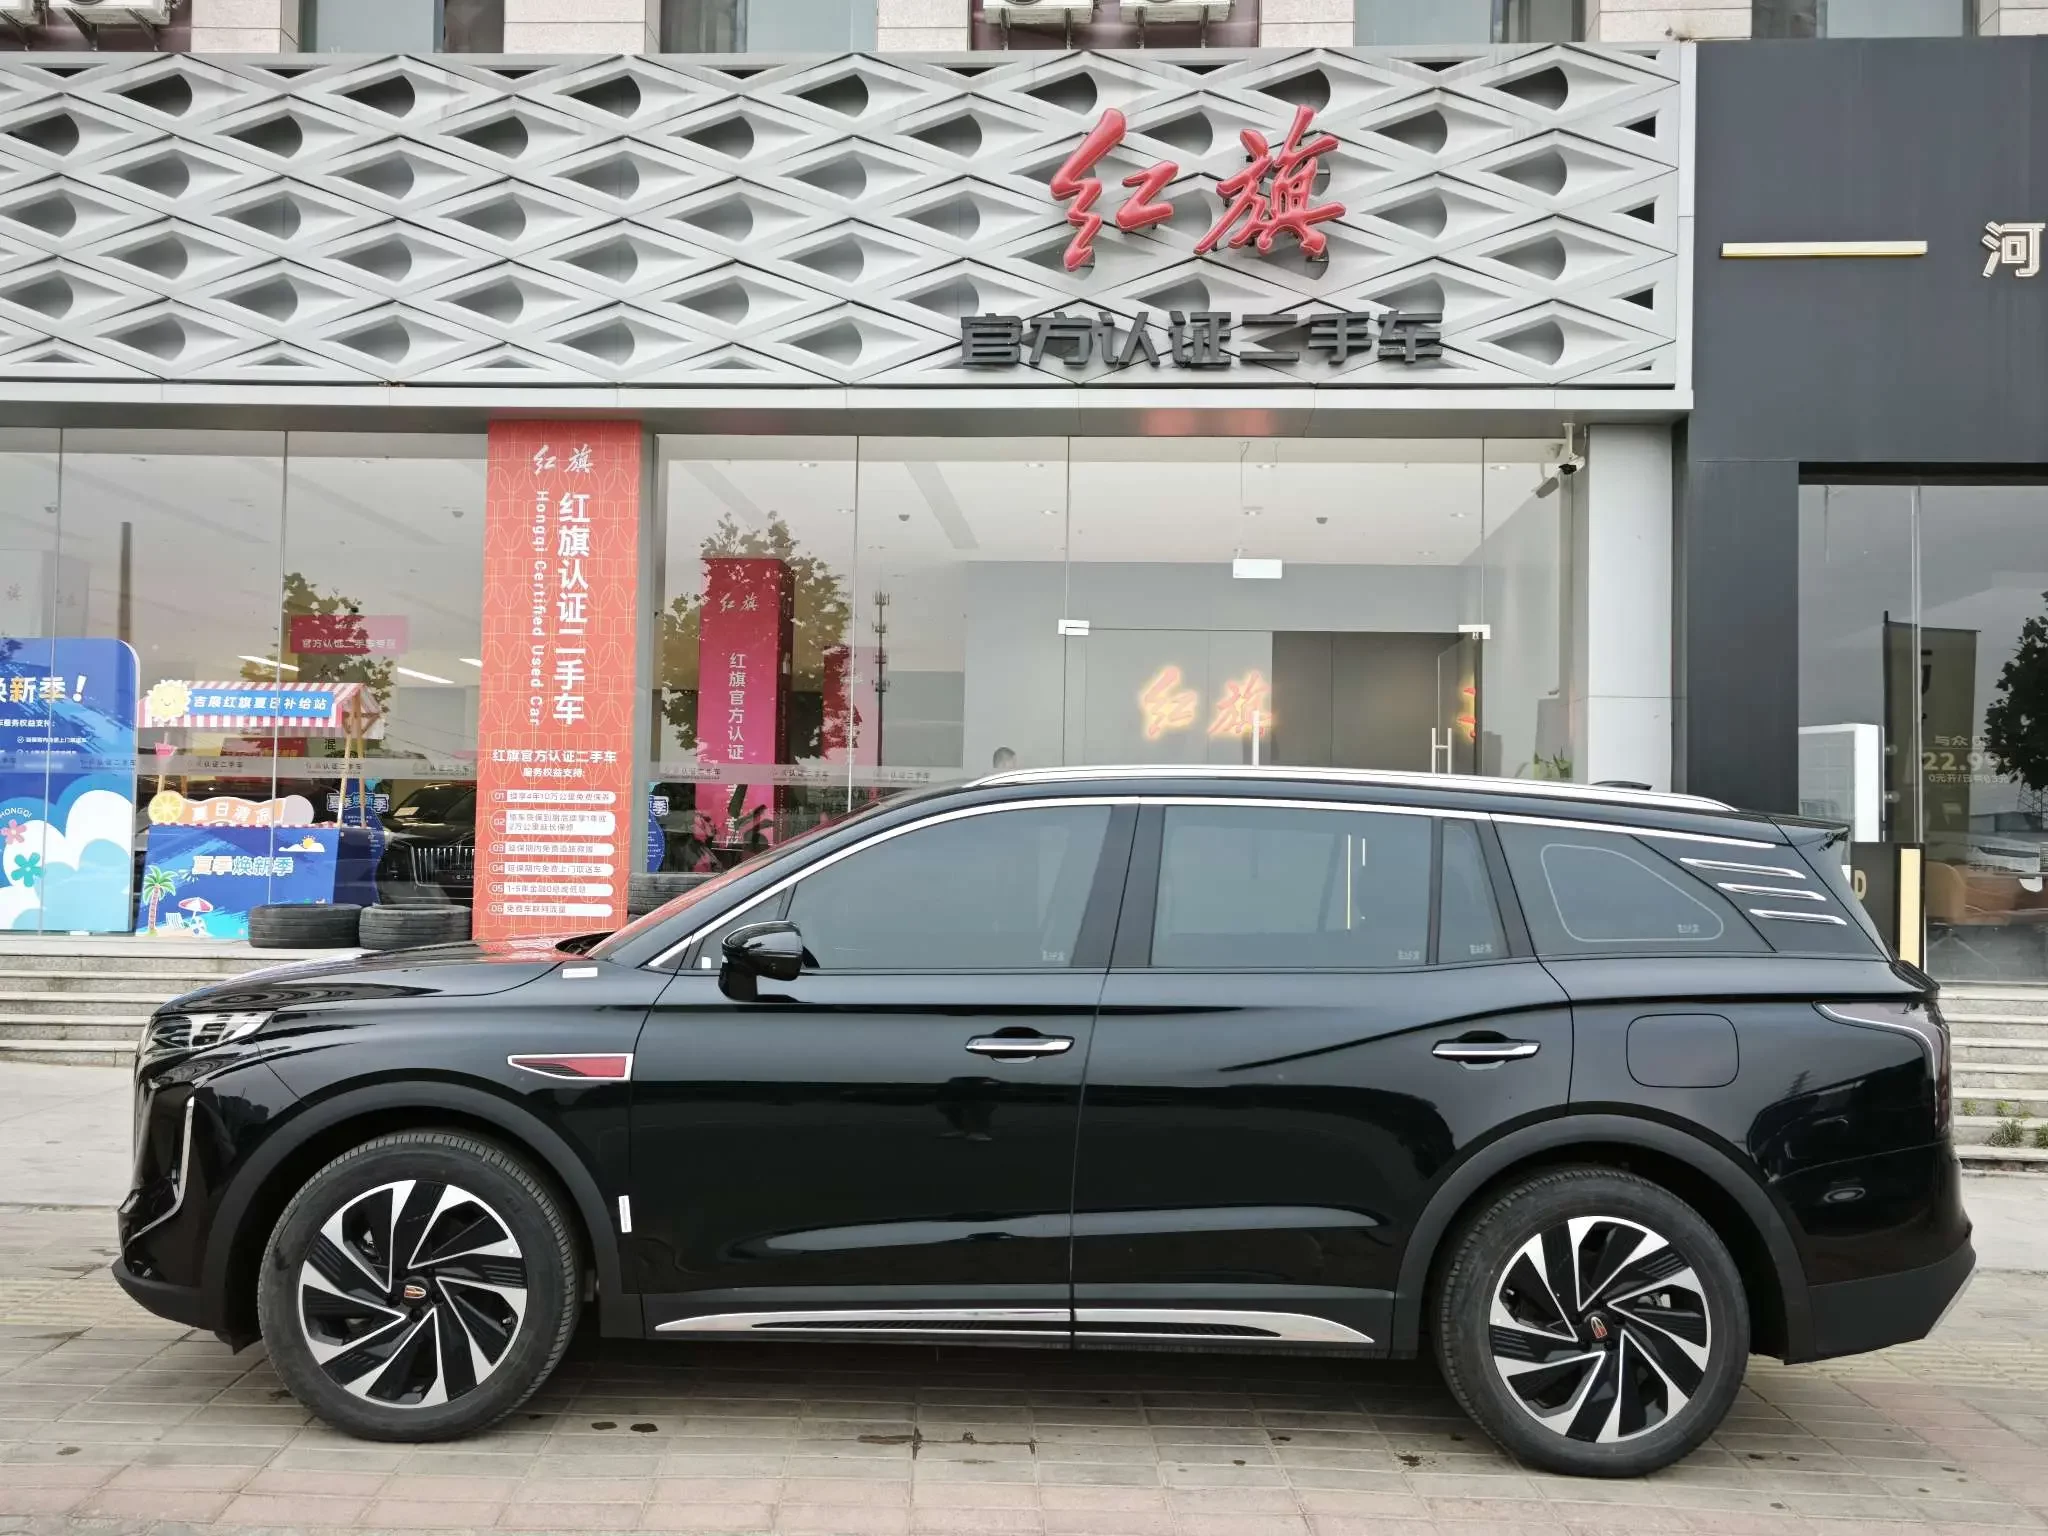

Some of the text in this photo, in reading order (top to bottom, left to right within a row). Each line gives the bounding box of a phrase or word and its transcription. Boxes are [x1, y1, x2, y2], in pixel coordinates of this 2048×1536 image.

[1049, 105, 1347, 272] 红旗
[1982, 221, 2046, 278] 河
[961, 310, 1442, 370] 官方认证二手车
[533, 444, 594, 476] 红旗
[529, 491, 549, 726] Hongqi Certified Used Car
[552, 492, 591, 726] 红旗认证二手车
[718, 592, 760, 614] 红旗
[1144, 667, 1273, 737] 红旗
[492, 749, 617, 764] 红旗官方认证二手车
